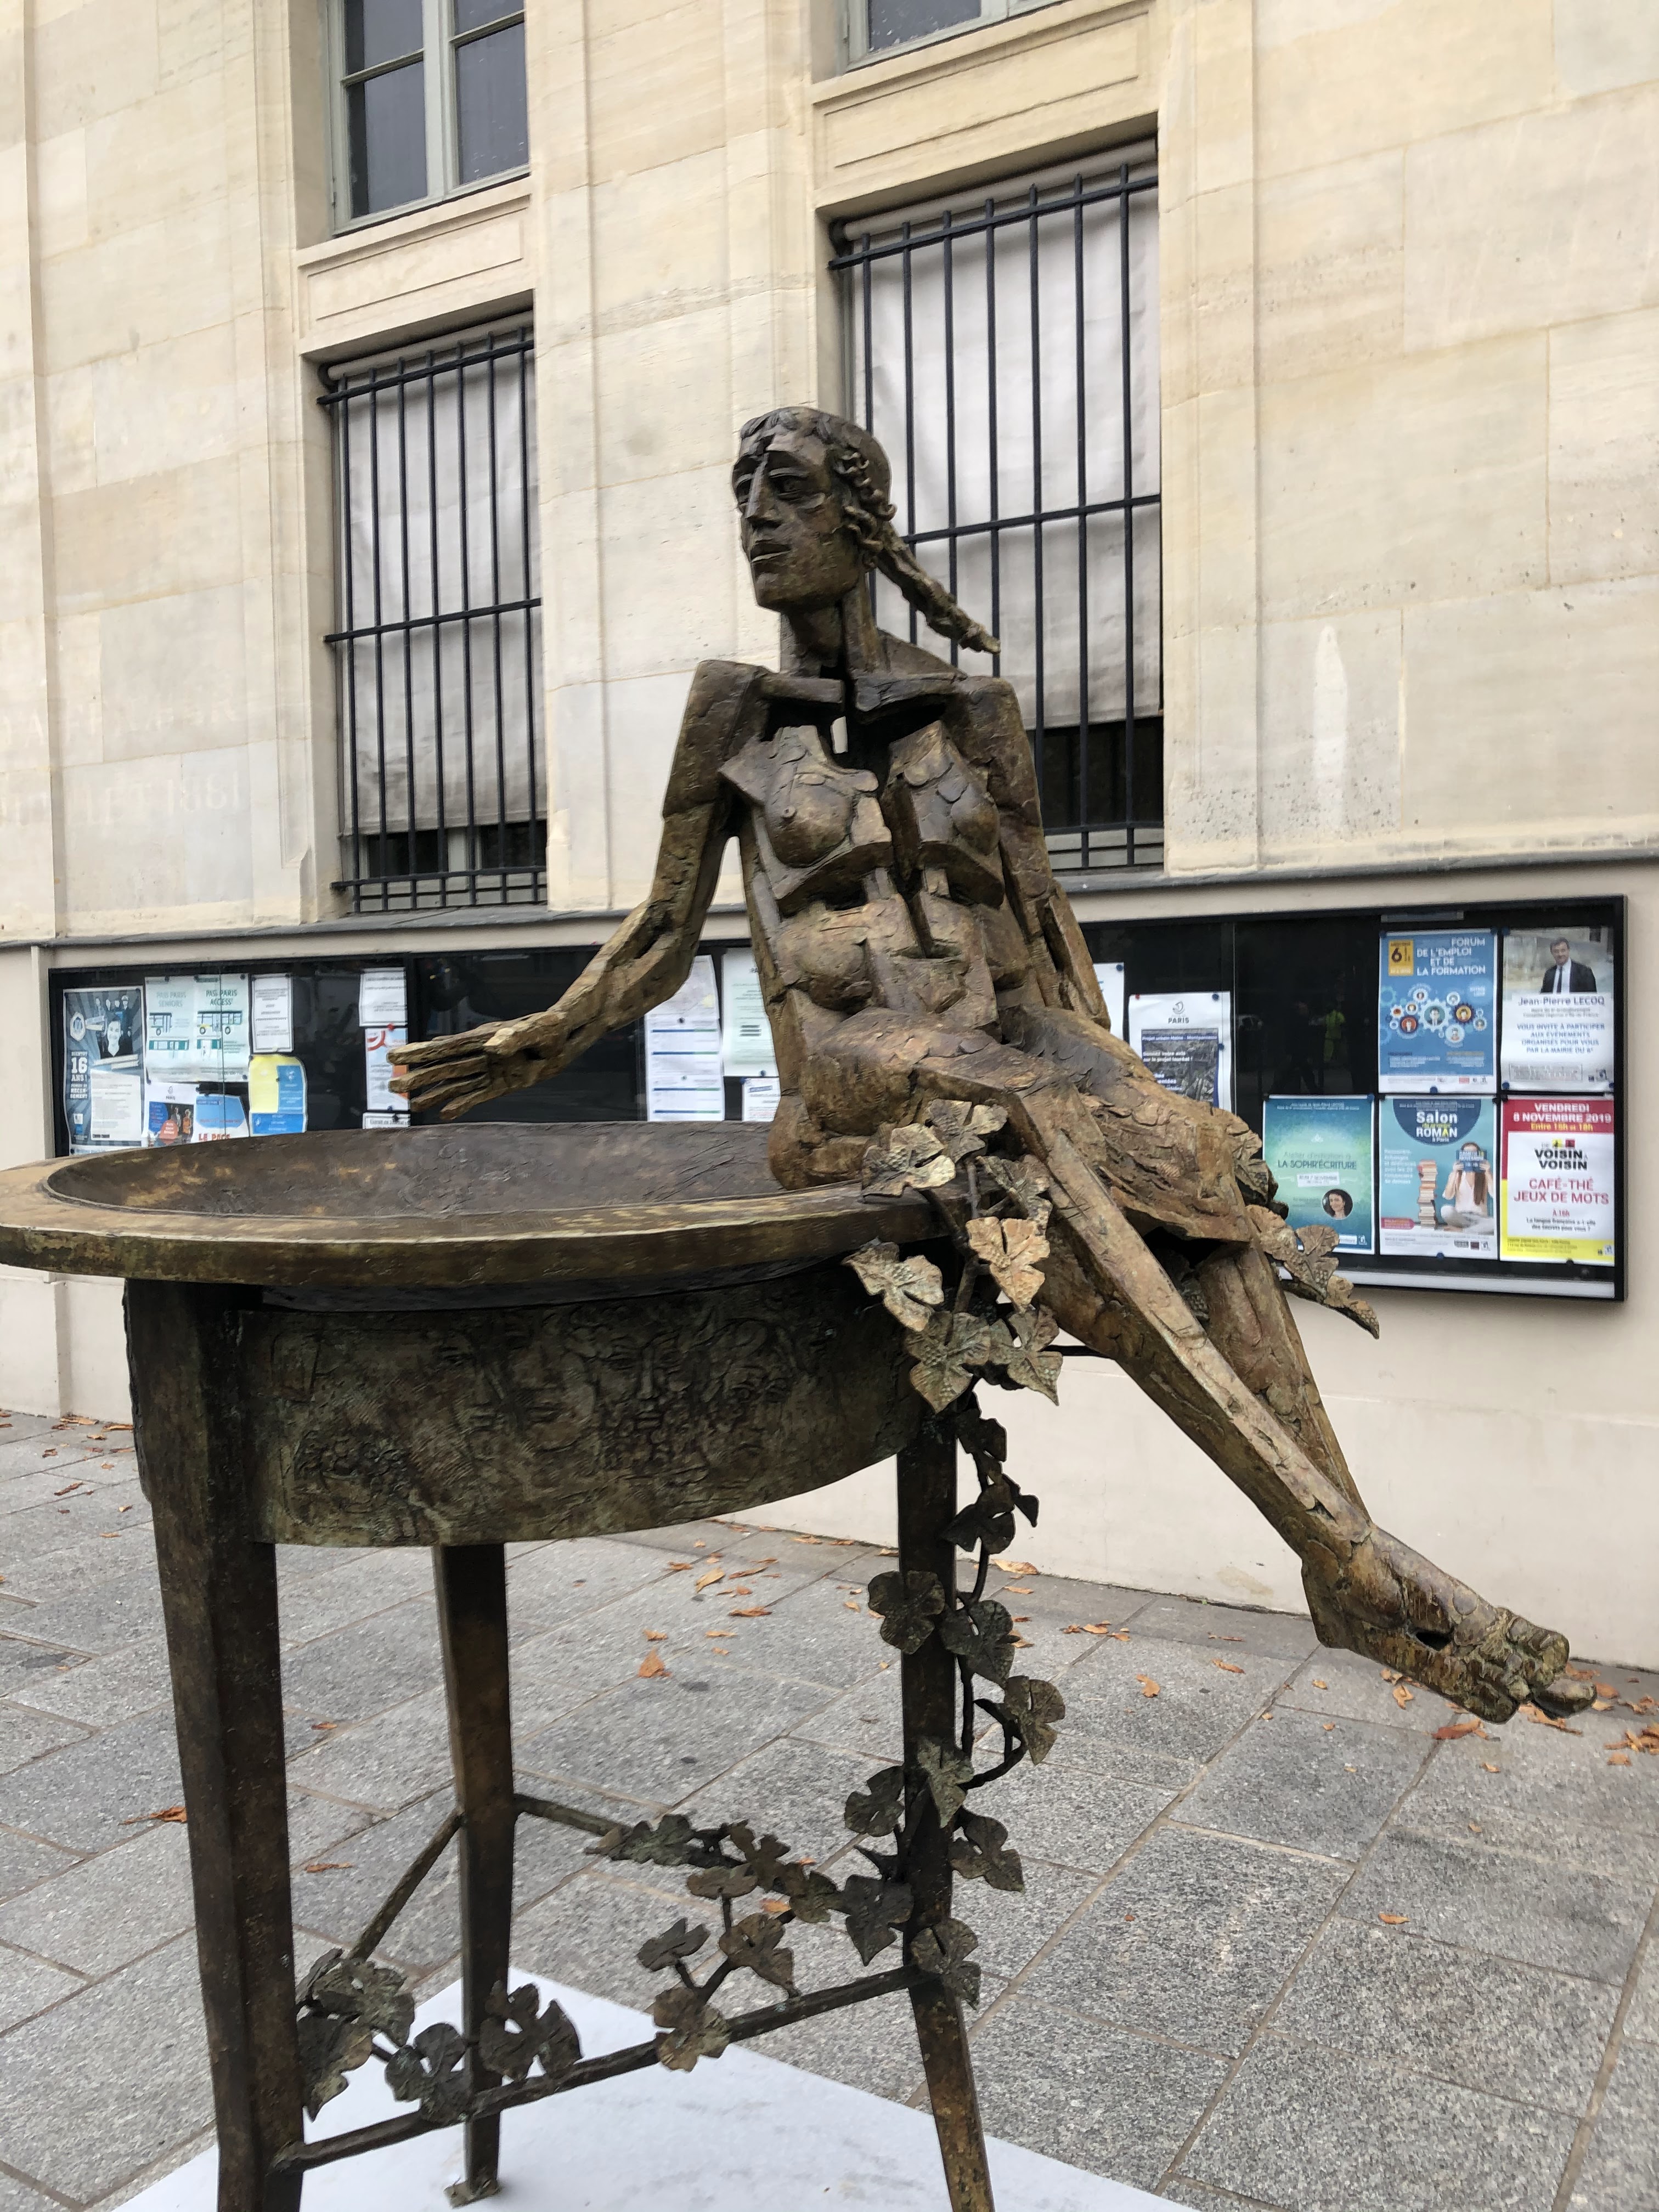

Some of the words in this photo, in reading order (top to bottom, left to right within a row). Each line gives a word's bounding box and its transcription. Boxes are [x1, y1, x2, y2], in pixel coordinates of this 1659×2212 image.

[1451, 937, 1485, 947] FORUM
[1417, 948, 1428, 957] DE
[1430, 947, 1472, 957] L'EMPLOI
[1430, 958, 1441, 967] ET
[1443, 957, 1454, 966] DE
[1417, 967, 1429, 976] LA
[1431, 965, 1486, 975] FORMATION
[1518, 996, 1571, 1006] Jean-Pierre
[1573, 996, 1605, 1006] LECOQ
[71, 1057, 87, 1074] 16
[1534, 1103, 1590, 1113] VENDREDI
[1416, 1109, 1457, 1124] Salon
[1522, 1113, 1583, 1122] NOVEMBRE
[1585, 1113, 1612, 1124] 2019
[1531, 1122, 1551, 1131] Entre
[1416, 1127, 1458, 1138] ROMAN
[1534, 1148, 1583, 1159] VOISIN
[1278, 1160, 1288, 1168] LA
[1290, 1158, 1357, 1170] SOPHR'ÉCRITURE
[1539, 1160, 1587, 1170] VOISIN
[1529, 1176, 1594, 1191] CAFÉ-THÉ
[1514, 1190, 1547, 1203] JEUX
[1551, 1192, 1567, 1203] DE
[1571, 1192, 1609, 1205] MOTS
